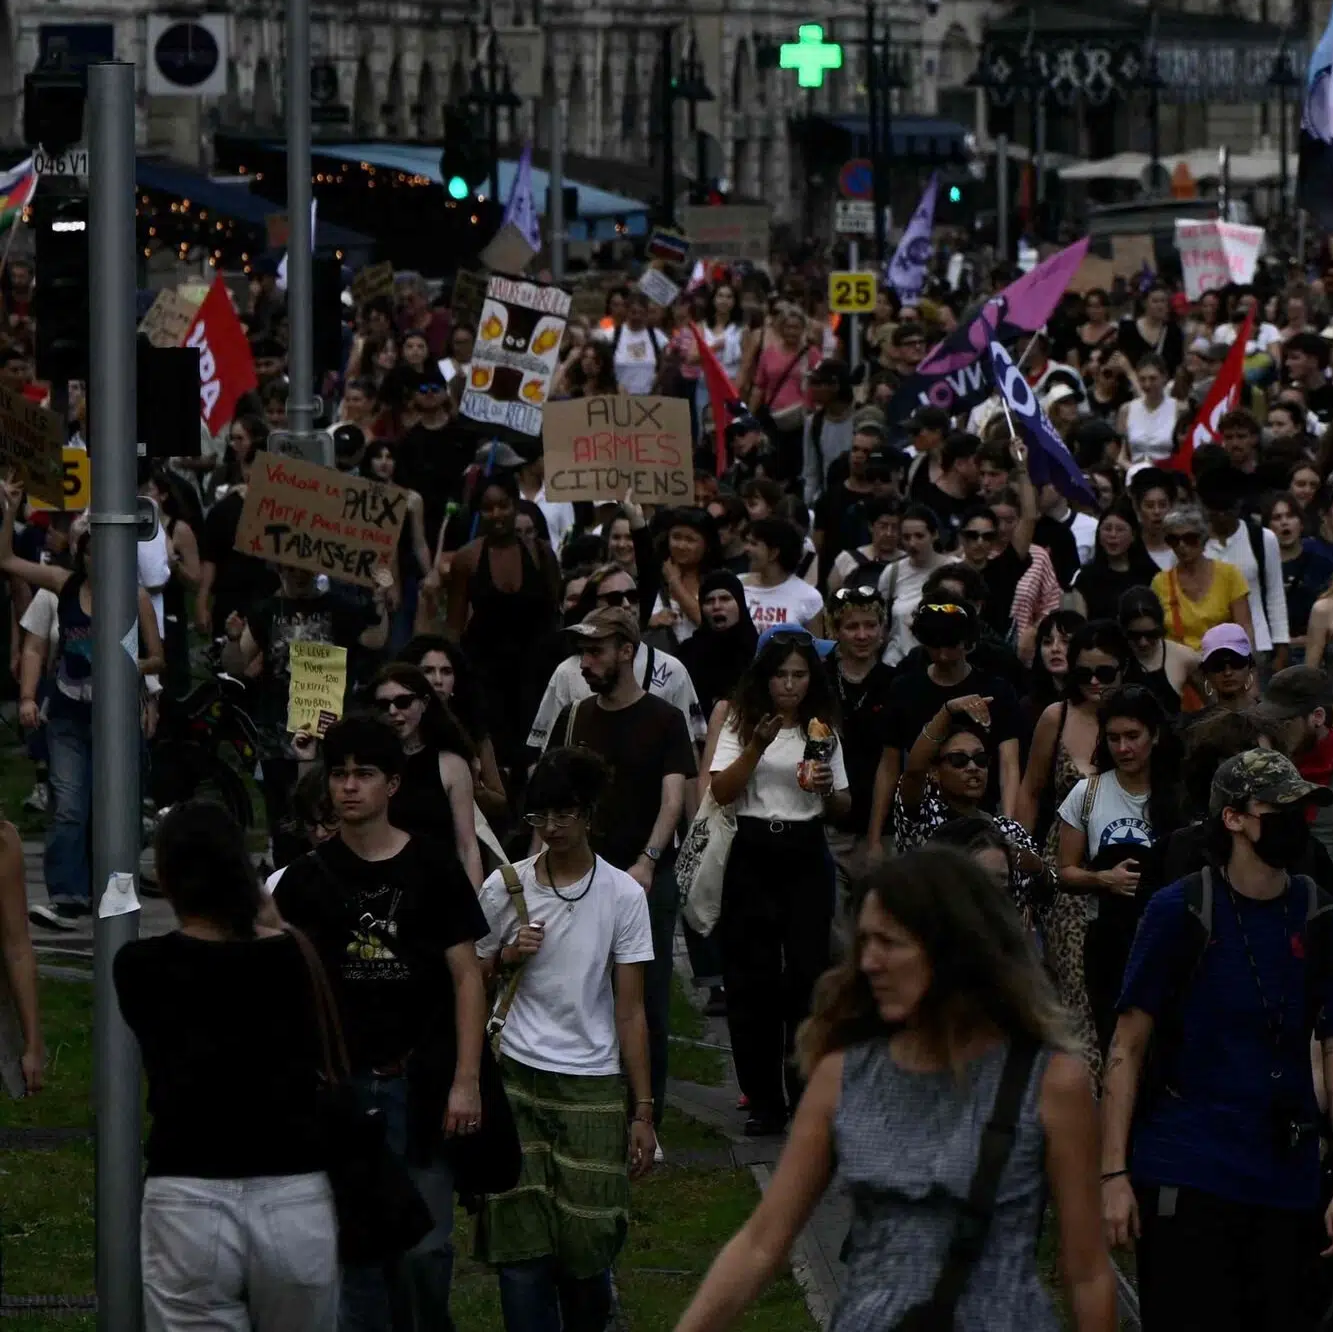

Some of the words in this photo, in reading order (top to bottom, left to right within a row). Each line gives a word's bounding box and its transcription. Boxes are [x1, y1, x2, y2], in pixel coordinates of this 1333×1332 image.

[835, 281, 871, 306] 25
[587, 398, 663, 430] AUX
[573, 432, 682, 467] ARMES
[63, 460, 81, 496] 5
[550, 467, 689, 496] CITOYENS
[343, 487, 407, 529] PAIX
[264, 525, 378, 578] TABASSER
[1125, 817, 1139, 828] DE
